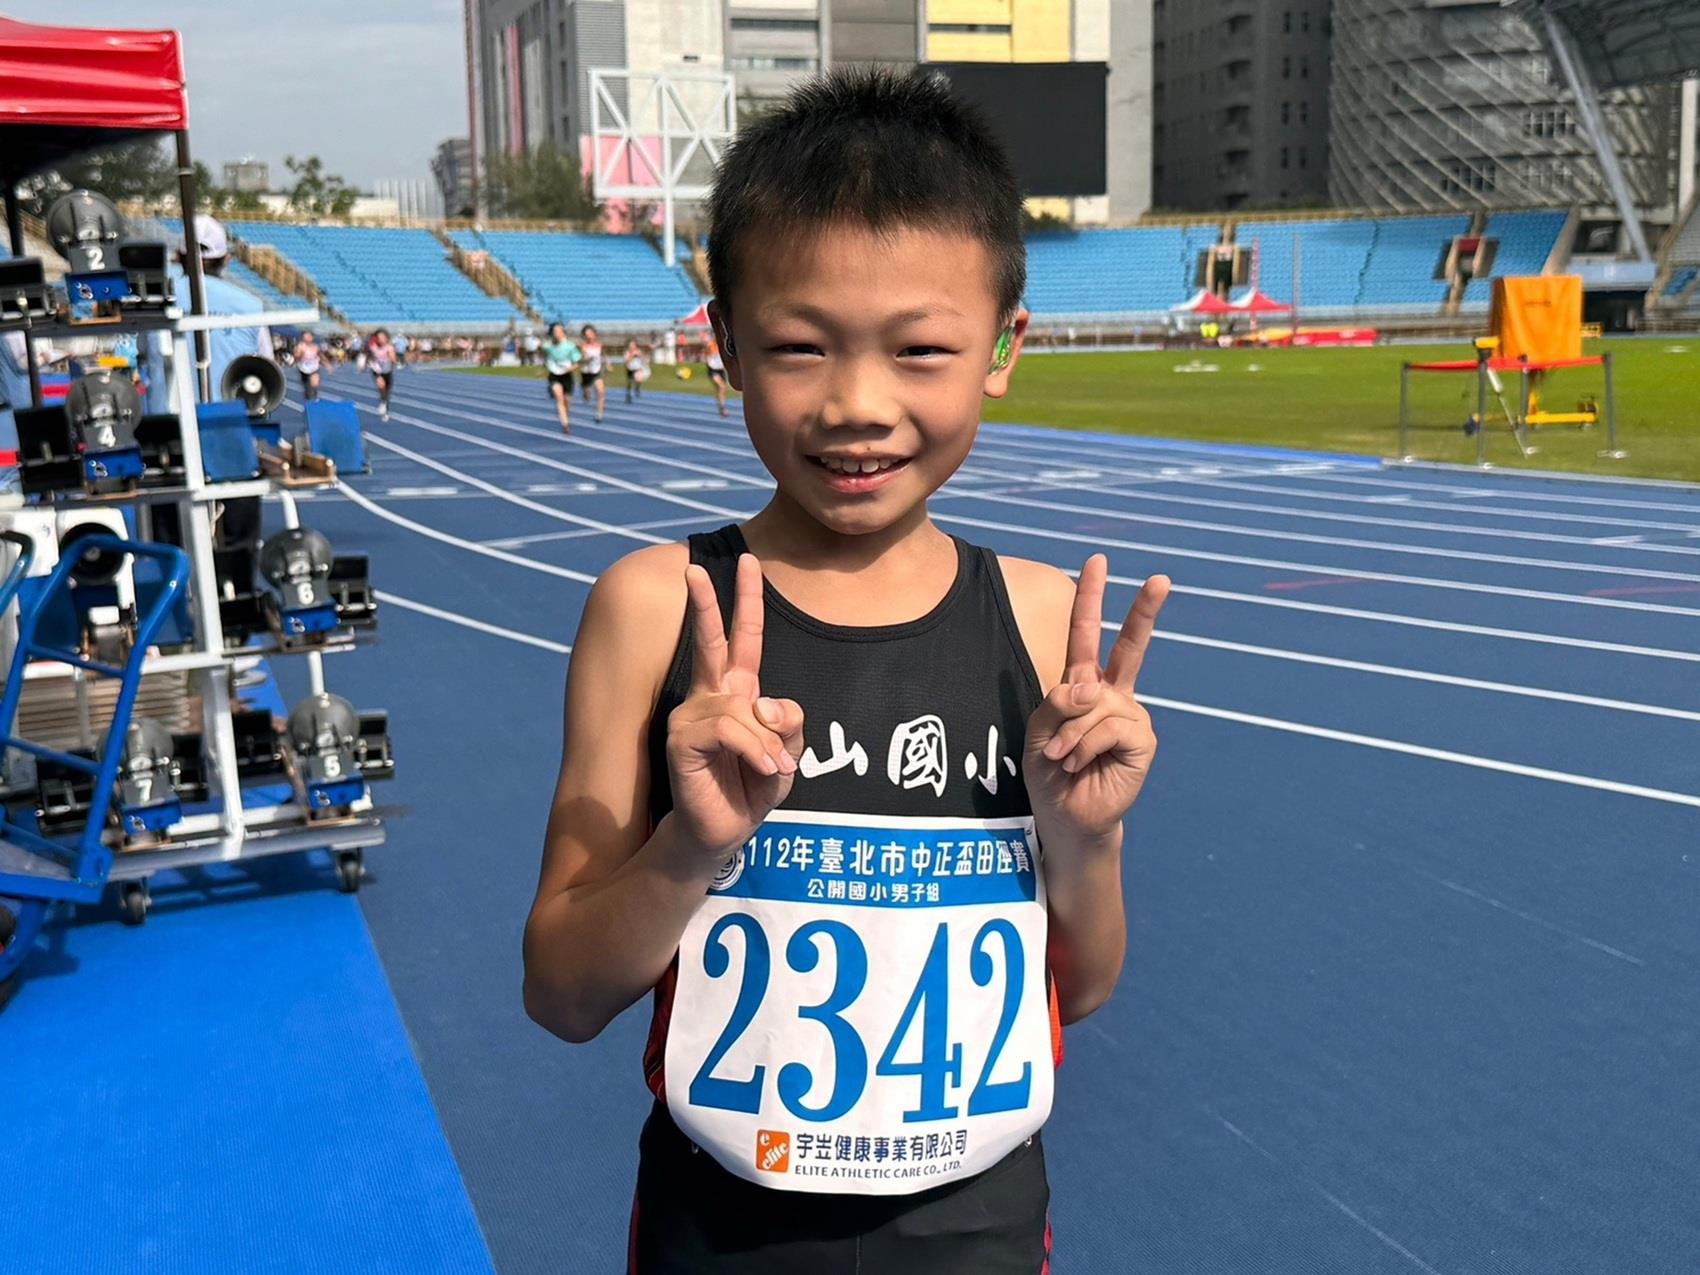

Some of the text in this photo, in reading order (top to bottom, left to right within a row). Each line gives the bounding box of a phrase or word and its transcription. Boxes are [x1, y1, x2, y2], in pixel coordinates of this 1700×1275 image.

[87, 247, 106, 271] 2
[99, 424, 116, 448] 4
[297, 582, 314, 605] 6
[324, 755, 341, 777] 5
[799, 714, 1017, 798] 山國小
[135, 779, 153, 802] 7
[807, 878, 940, 903] 公開國小男子組
[688, 911, 1032, 1124] 2342
[795, 1164, 828, 1177] ELITE
[831, 1166, 891, 1179] ATHLETIC
[893, 1167, 922, 1179] CARE
